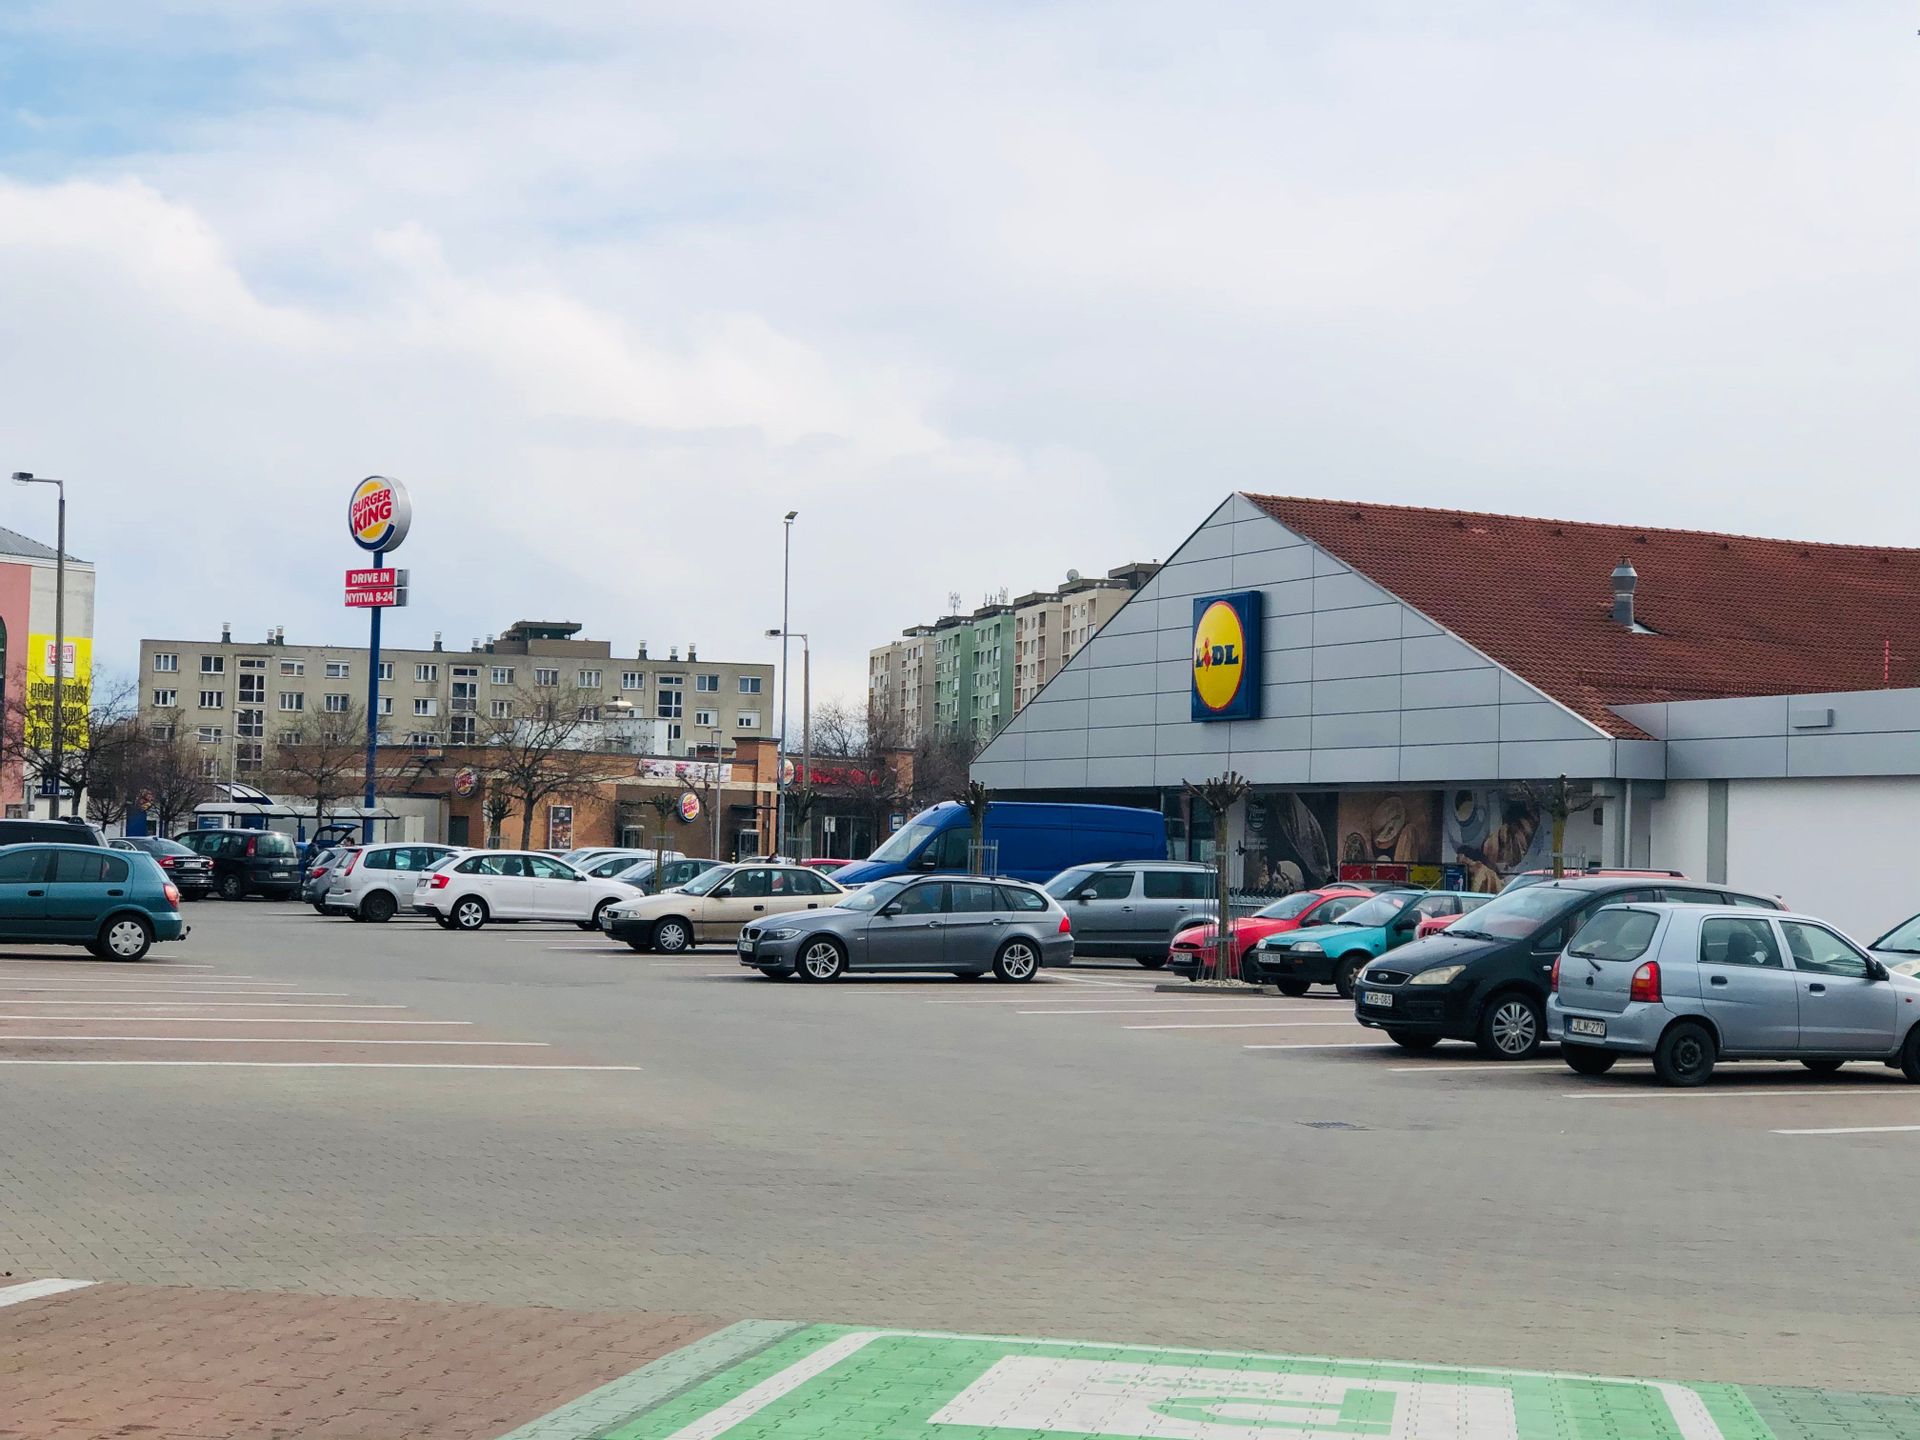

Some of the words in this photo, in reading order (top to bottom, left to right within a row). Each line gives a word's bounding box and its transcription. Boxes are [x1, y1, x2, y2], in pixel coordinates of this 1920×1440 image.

[352, 489, 391, 517] BURGER
[353, 501, 392, 536] KING
[351, 573, 378, 584] DRIVE
[380, 572, 389, 582] IN
[345, 592, 373, 603] NYITVA
[375, 590, 393, 601] 8-24
